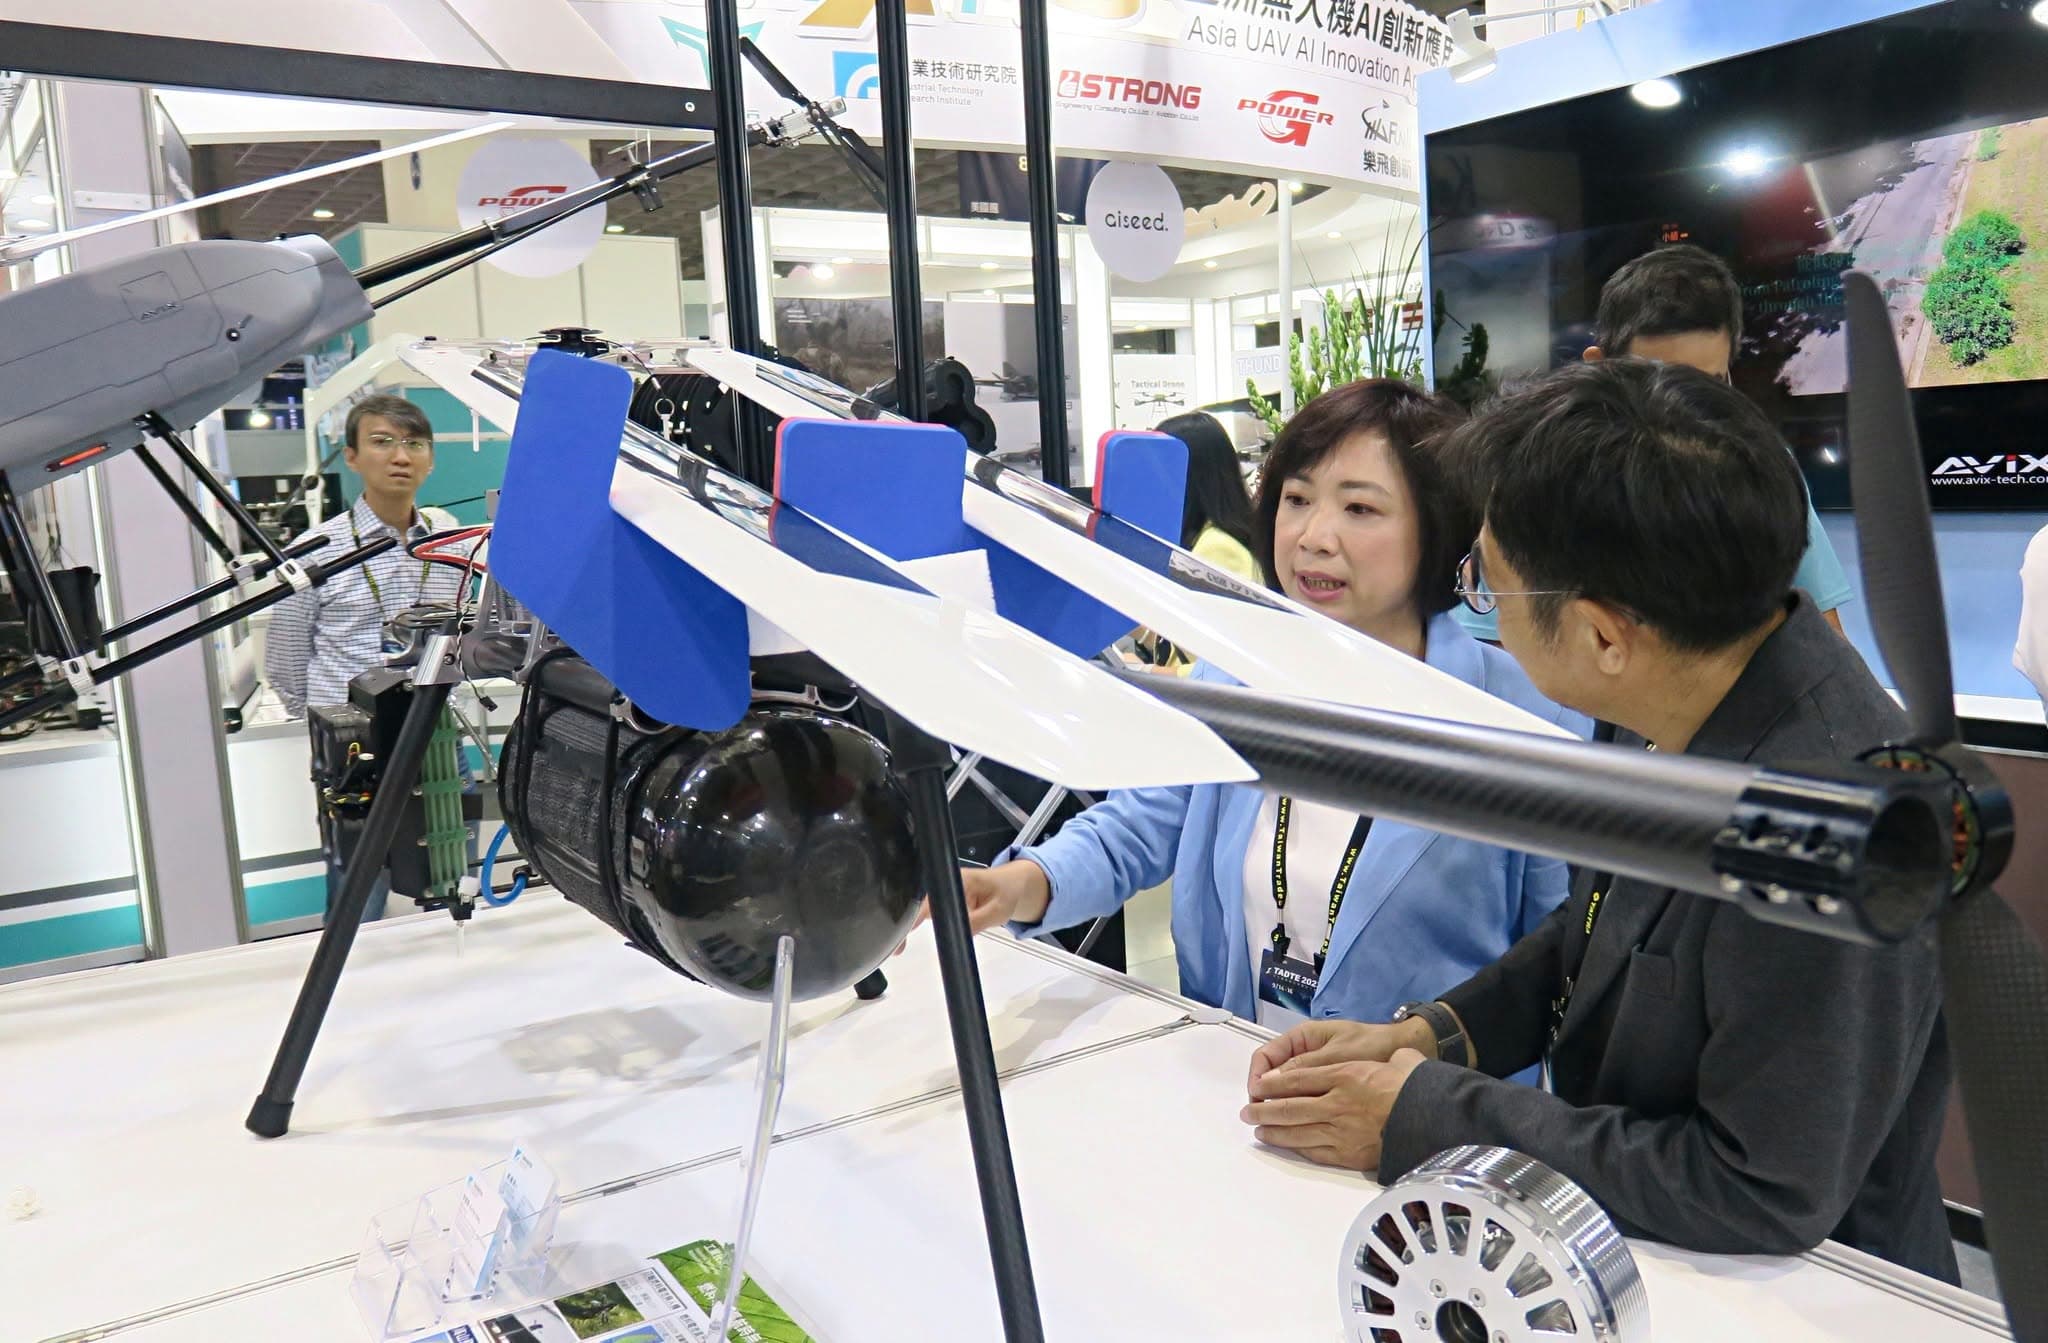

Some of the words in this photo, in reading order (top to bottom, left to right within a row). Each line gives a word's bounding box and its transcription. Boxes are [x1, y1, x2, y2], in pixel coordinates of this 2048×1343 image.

[1188, 15, 1236, 48] Asia
[1246, 25, 1292, 57] UAV
[1296, 37, 1315, 62] AI
[1322, 42, 1400, 85] Innovation
[911, 58, 1017, 85] 業技術研究院
[938, 83, 984, 97] Technology
[1080, 74, 1201, 110] STRONG
[1237, 98, 1335, 126] POWER
[1131, 380, 1161, 389] Tactical
[1274, 966, 1302, 982] TADTE
[1301, 976, 1319, 989] 202
